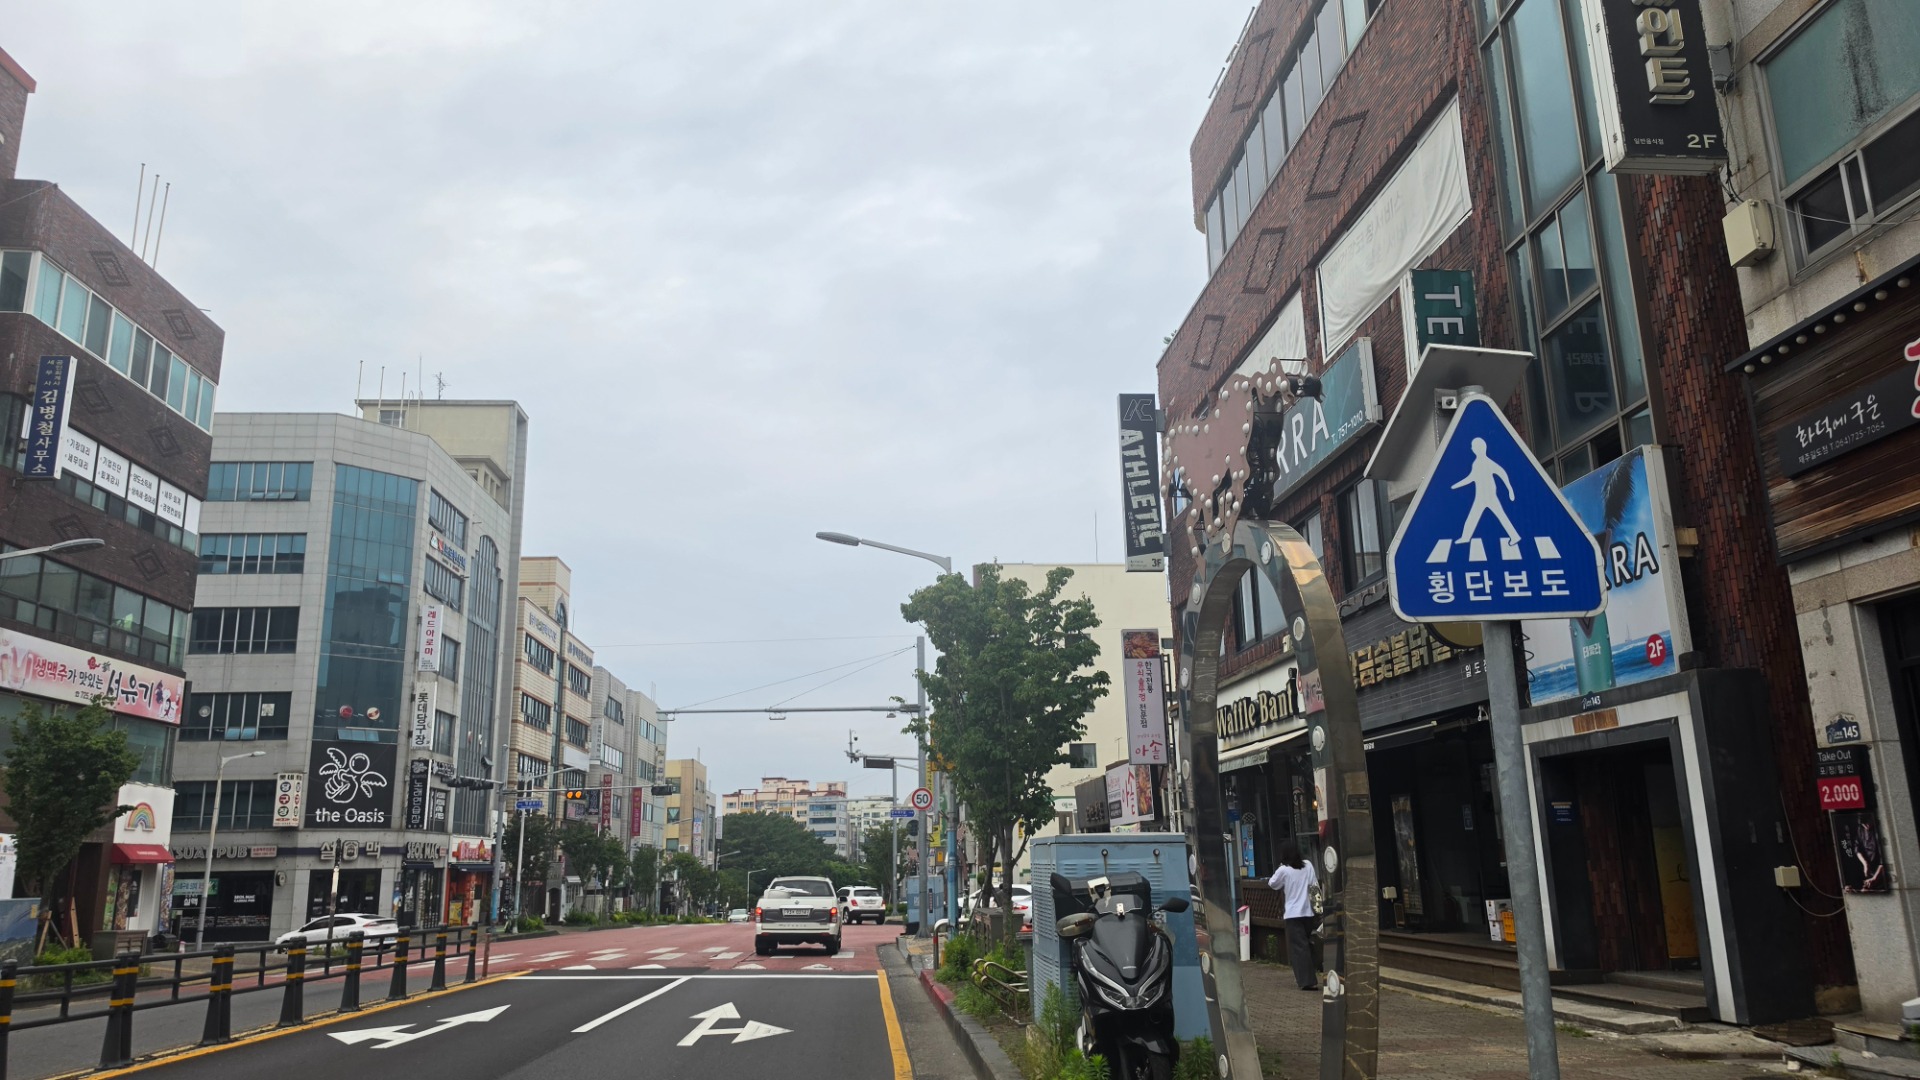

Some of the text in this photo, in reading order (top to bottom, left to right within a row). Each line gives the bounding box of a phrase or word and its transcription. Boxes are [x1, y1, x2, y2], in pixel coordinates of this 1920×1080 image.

[1631, 0, 1695, 105] 인트
[1686, 133, 1717, 149] 2F
[1795, 393, 1881, 448] 화덕에 구운
[31, 389, 59, 475] 김병철사무소
[1151, 558, 1162, 568] 3F
[1606, 531, 1660, 591] RA
[1427, 569, 1571, 604] 횡단보도
[424, 610, 437, 656] 레드아로마
[1647, 639, 1664, 659] 2F
[35, 657, 104, 690] 생맥주가 맛있는
[1216, 682, 1297, 739] Waffle Bant
[1842, 725, 1859, 739] 145
[1817, 749, 1852, 763] Take Out
[916, 793, 929, 805] 50
[1821, 783, 1860, 803] 2.000
[315, 807, 385, 823] the Oasis
[216, 846, 248, 859] PUB
[406, 841, 424, 860] SEOL
[423, 842, 440, 860] MAC
